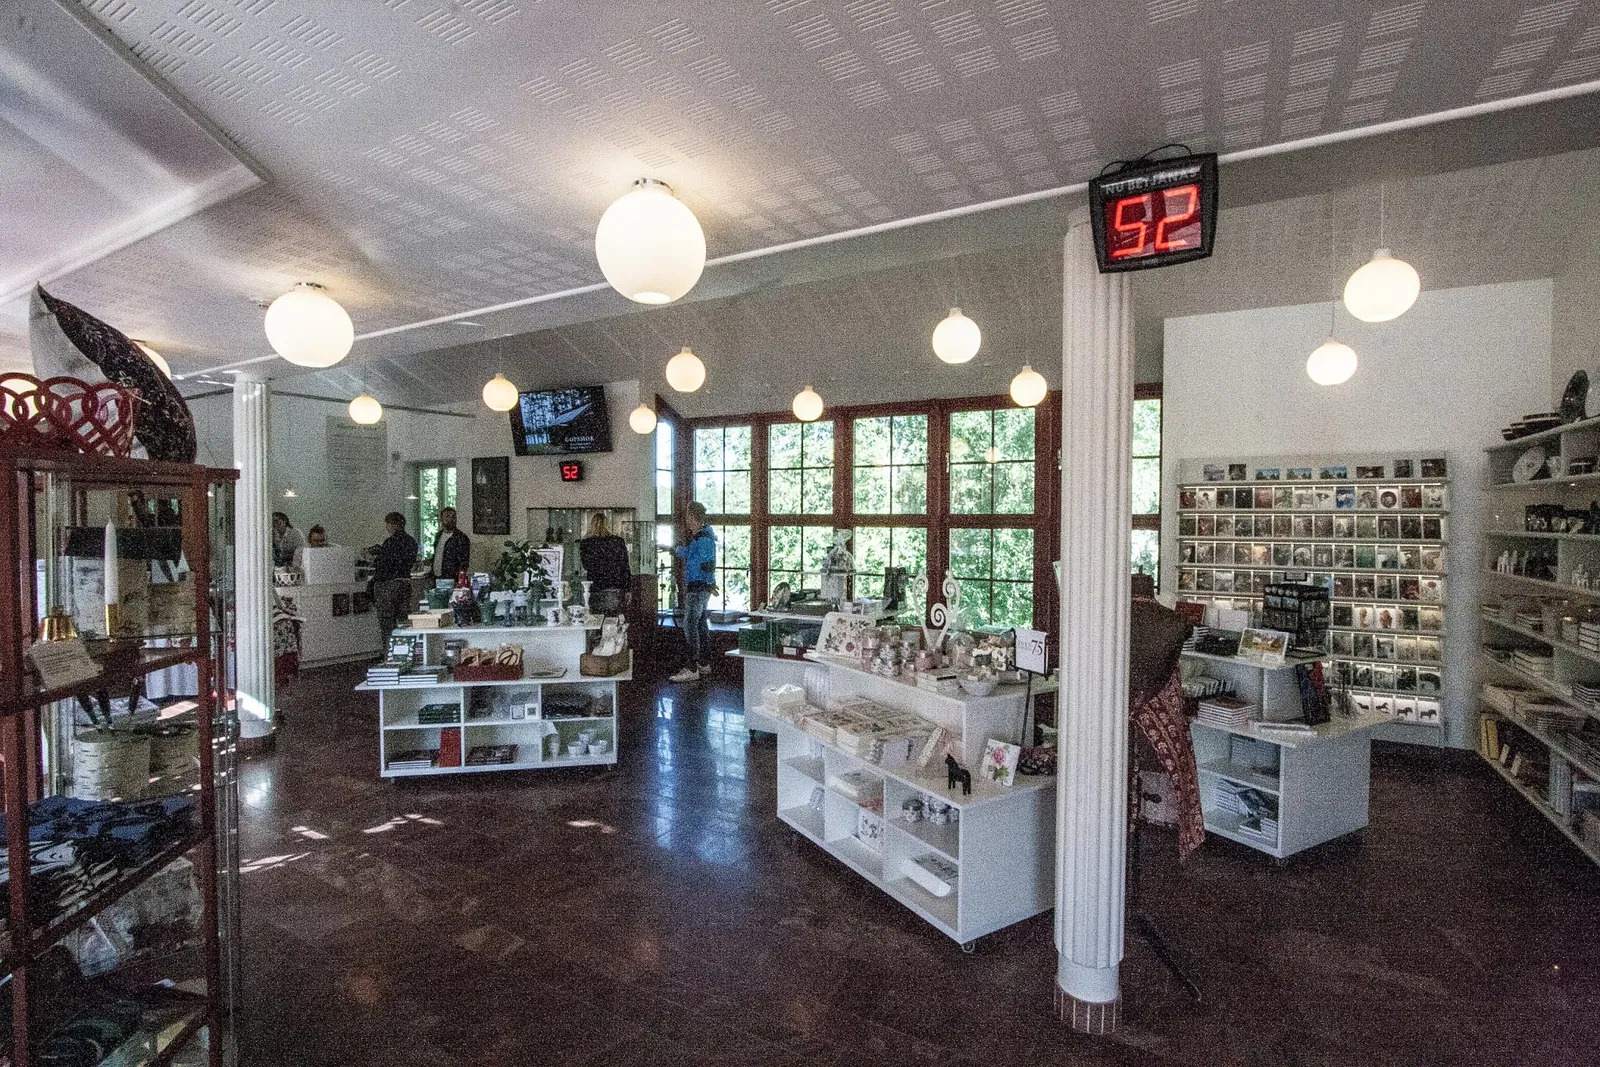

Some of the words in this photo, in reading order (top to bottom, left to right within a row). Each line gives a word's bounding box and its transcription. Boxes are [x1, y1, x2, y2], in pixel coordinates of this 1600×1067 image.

[1111, 185, 1198, 257] 52
[563, 465, 578, 479] 52
[1031, 639, 1043, 656] 75
